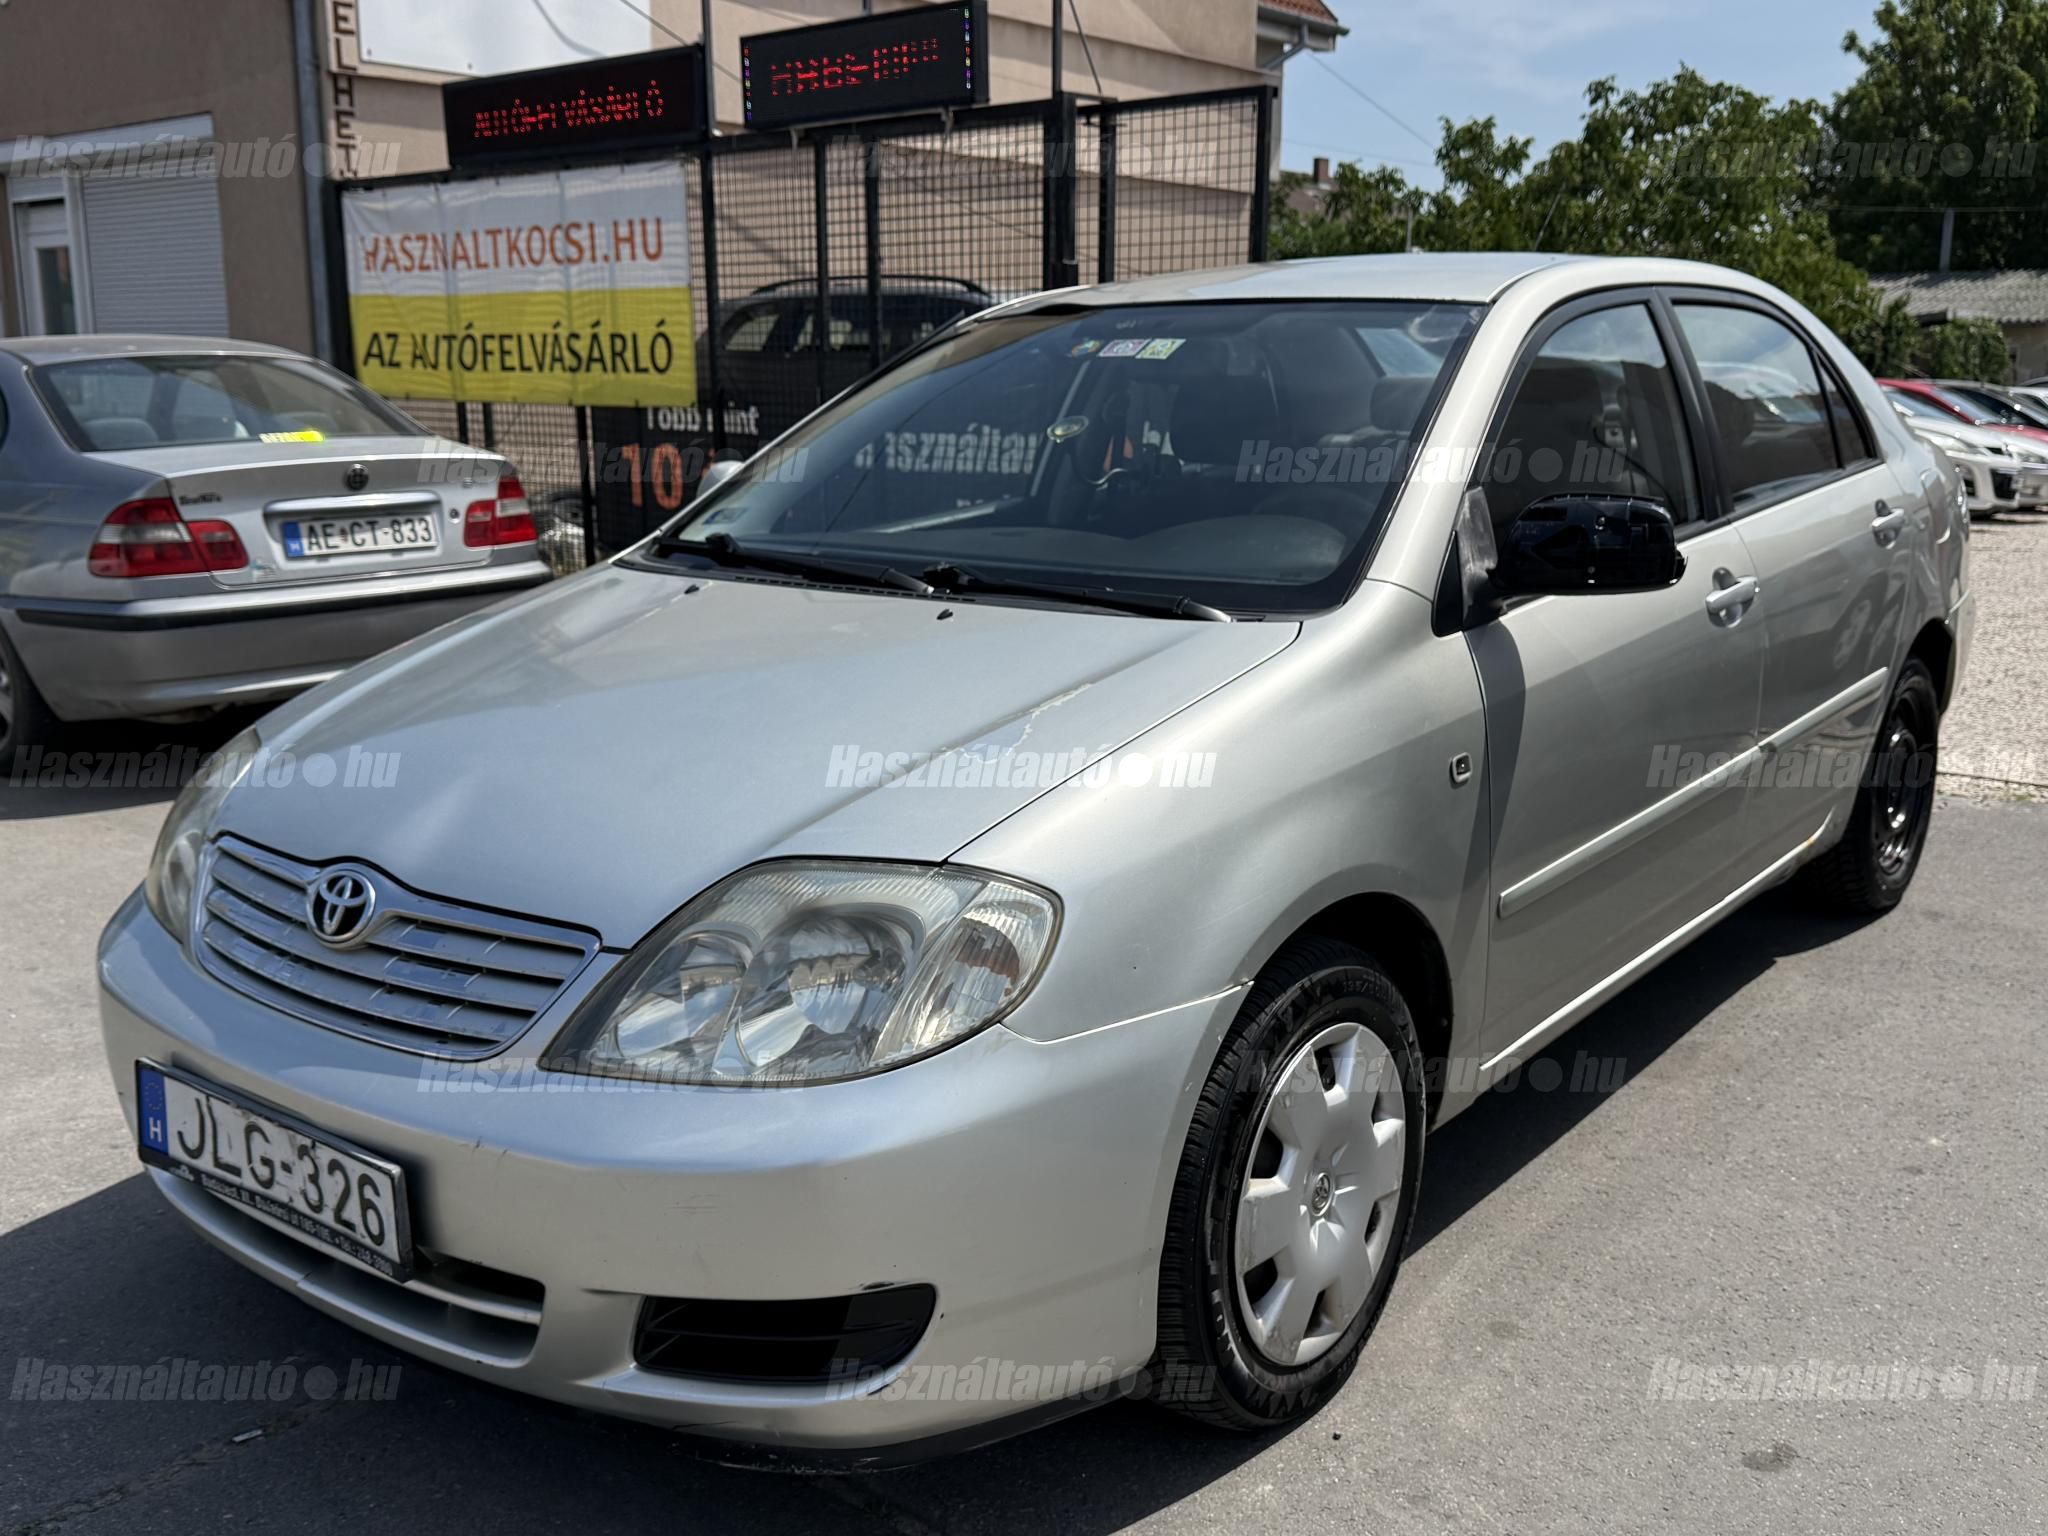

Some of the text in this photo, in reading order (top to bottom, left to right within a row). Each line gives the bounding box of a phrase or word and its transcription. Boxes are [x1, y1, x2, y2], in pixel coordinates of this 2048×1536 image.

[363, 332, 401, 367] AZ
[149, 1117, 163, 1143] H
[177, 1095, 386, 1247] JLG-326
